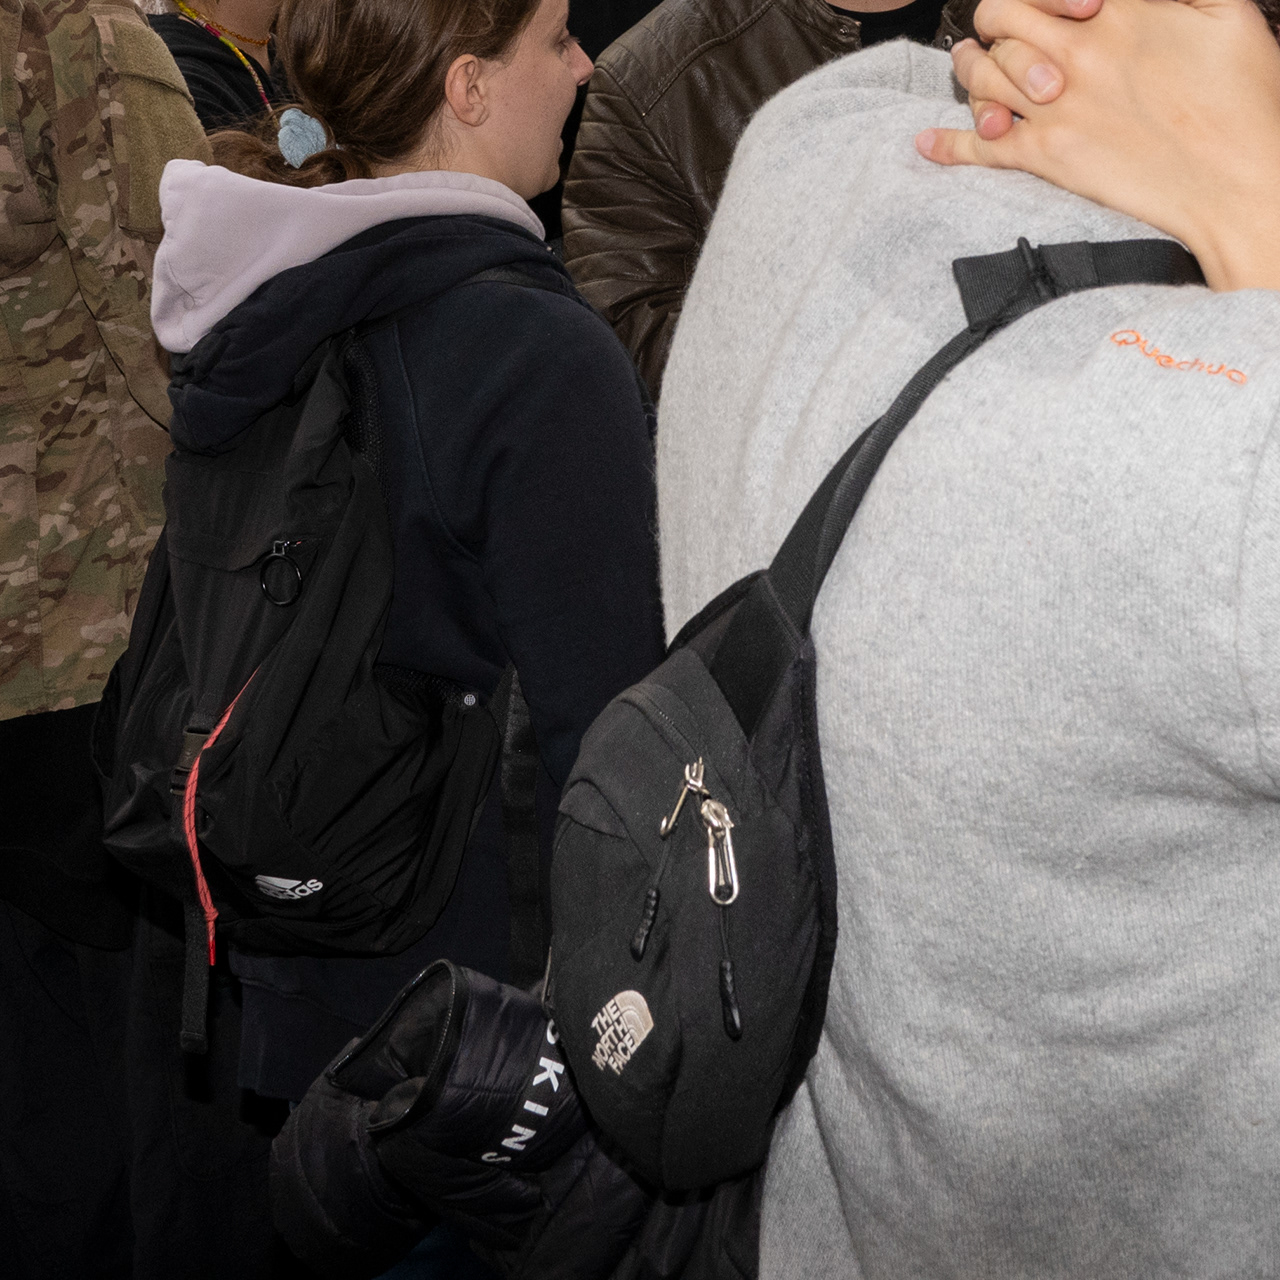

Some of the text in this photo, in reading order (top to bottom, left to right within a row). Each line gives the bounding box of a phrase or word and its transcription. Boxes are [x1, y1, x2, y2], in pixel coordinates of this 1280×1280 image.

[591, 998, 621, 1037] THE
[591, 1015, 628, 1071] NORTH
[607, 1032, 637, 1076] FACE
